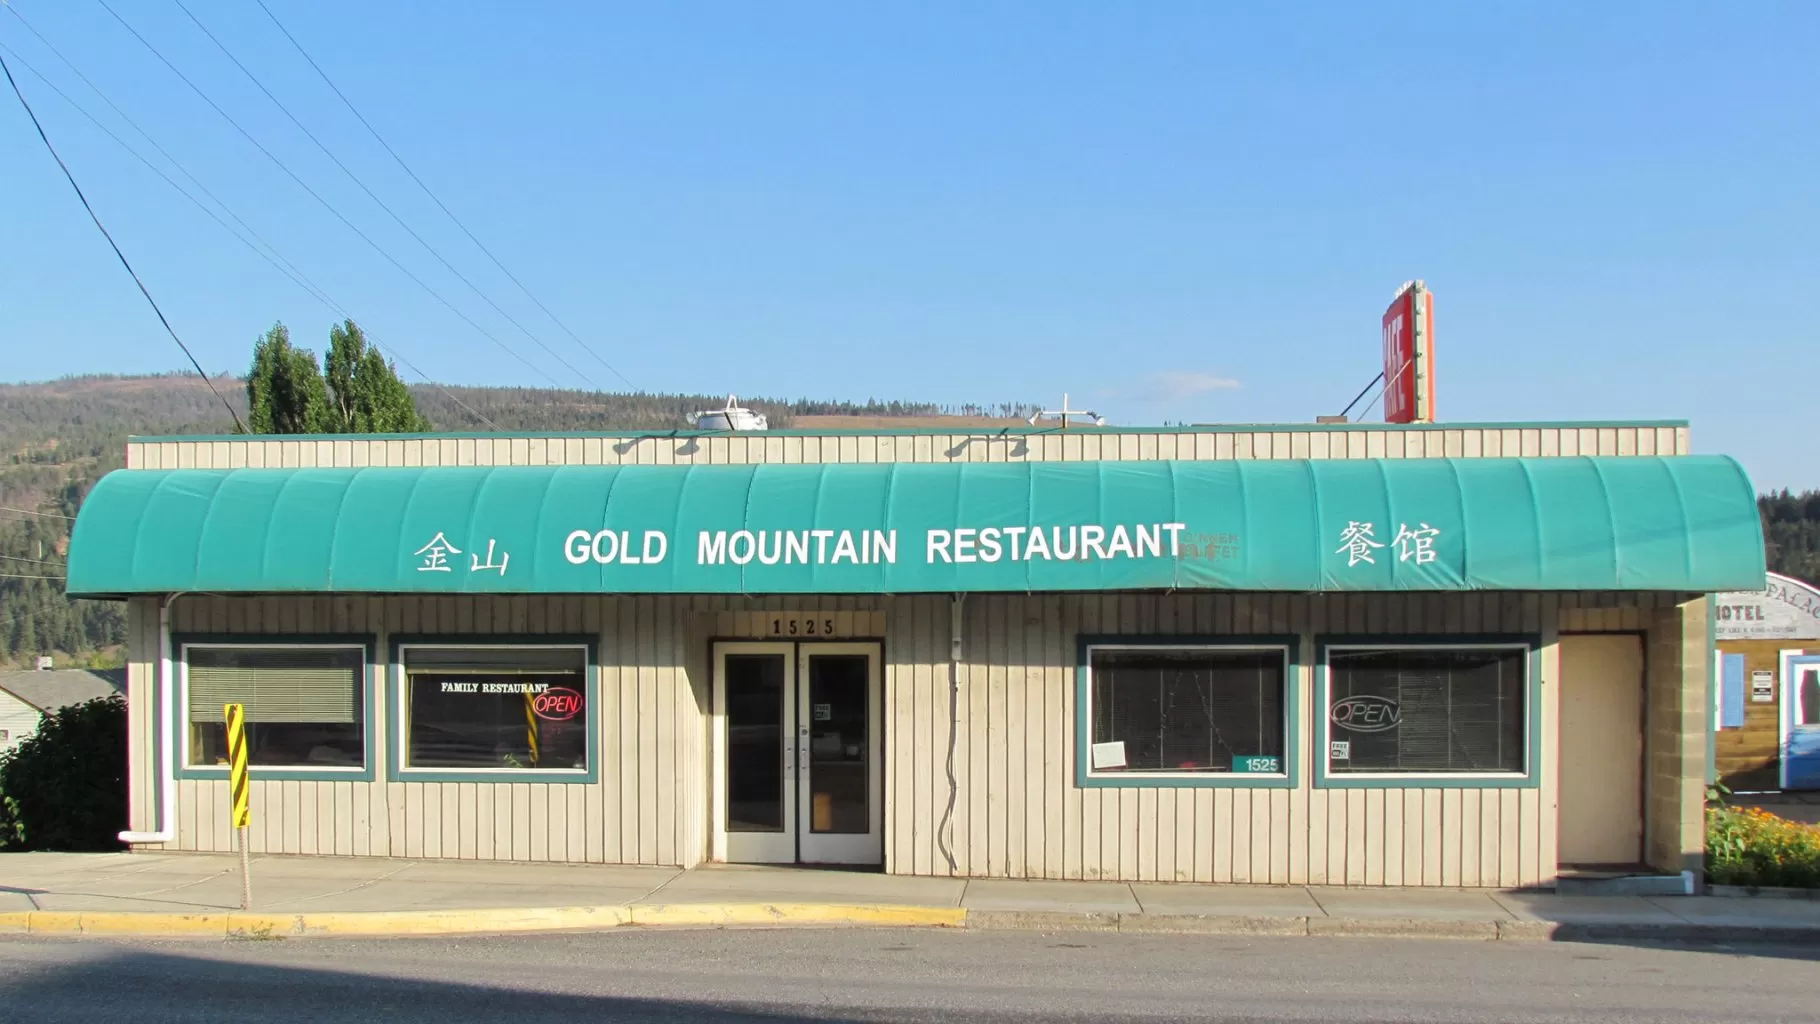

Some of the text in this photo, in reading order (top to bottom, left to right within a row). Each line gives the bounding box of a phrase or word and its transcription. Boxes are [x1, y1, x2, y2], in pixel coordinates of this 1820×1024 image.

[564, 523, 1185, 565] GOLD MOUNTAIN RESTAURANT
[1335, 520, 1440, 568] 餐馆
[414, 531, 510, 577] 金山
[773, 619, 833, 636] 1525
[441, 682, 549, 693] FAMILY RESTAURANT
[535, 695, 578, 713] OPEN
[1333, 702, 1401, 722] OPEN
[1246, 758, 1279, 772] 1525
